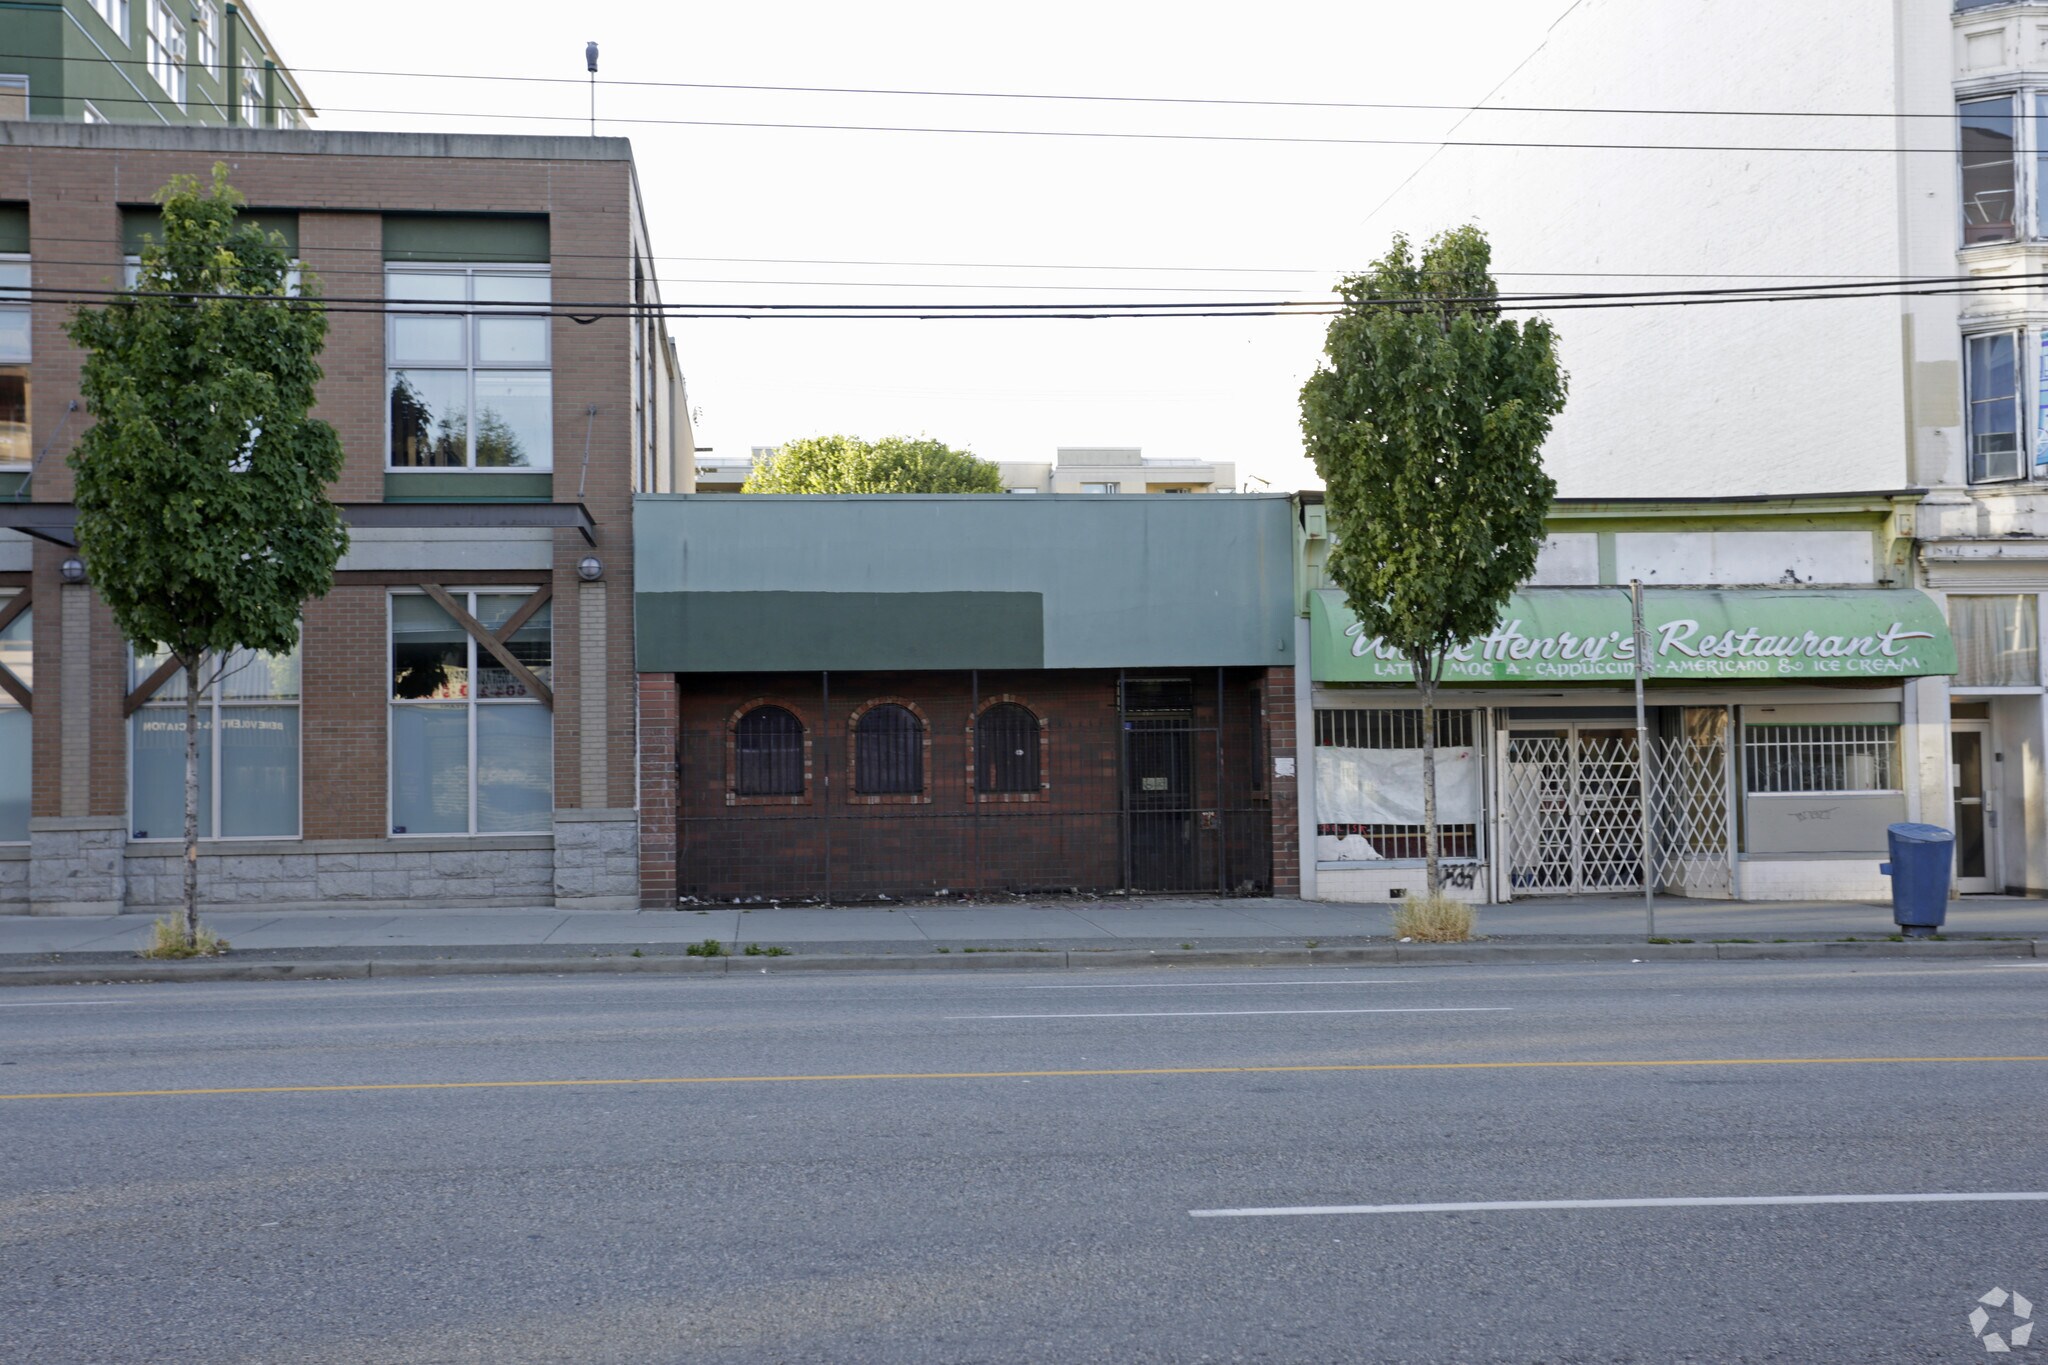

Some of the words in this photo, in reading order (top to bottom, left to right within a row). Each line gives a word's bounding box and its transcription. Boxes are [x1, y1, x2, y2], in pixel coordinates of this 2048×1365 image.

[1479, 619, 1635, 663] Henry's
[1657, 619, 1936, 658] Restaurant
[1449, 662, 1520, 676] MOCA
[1665, 657, 1769, 675] AMERICANO
[1777, 657, 1804, 674] &
[1814, 657, 1841, 672] ICE
[1846, 656, 1921, 674] CREAM
